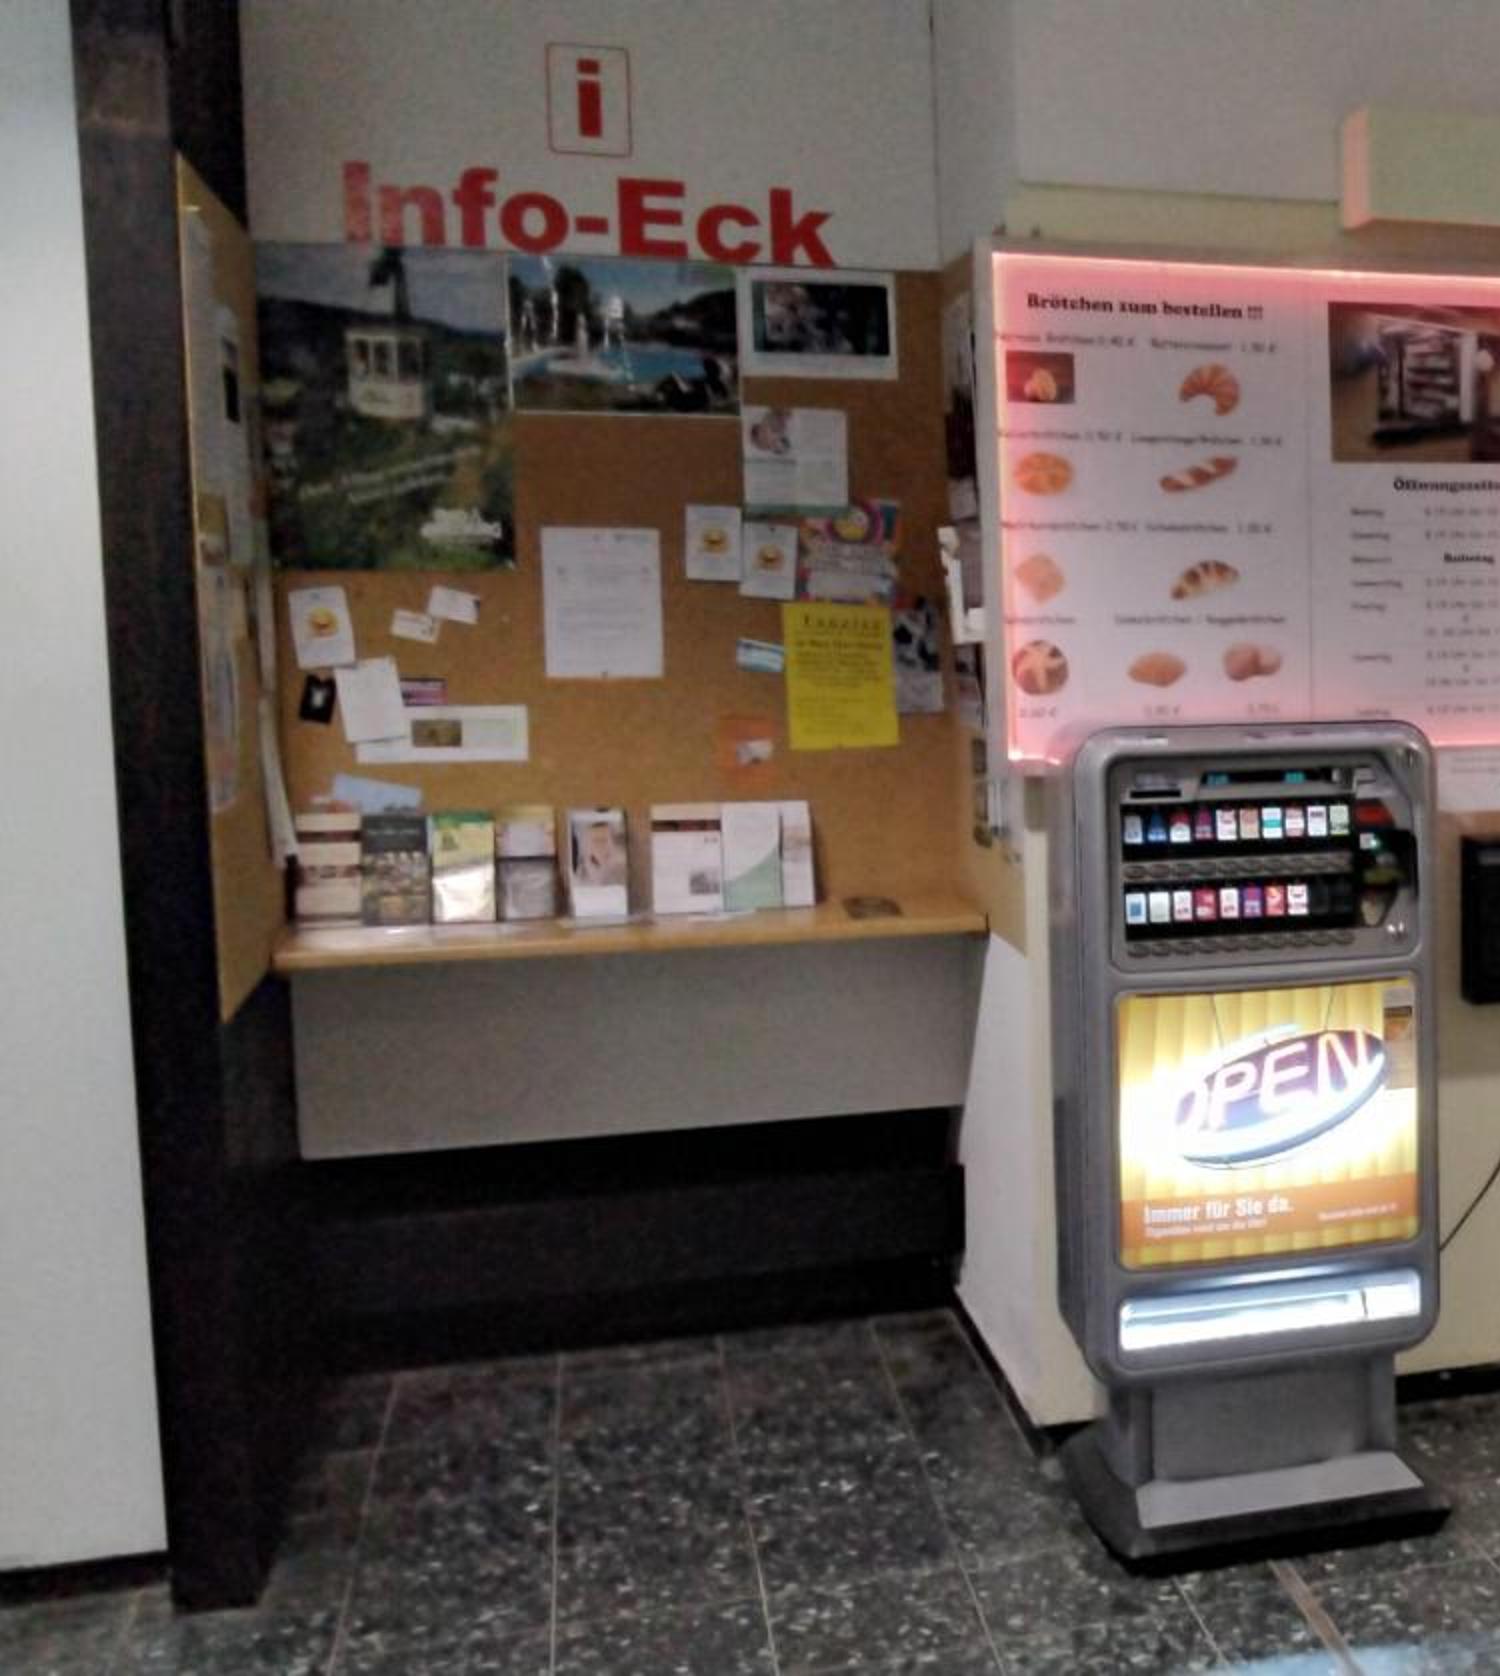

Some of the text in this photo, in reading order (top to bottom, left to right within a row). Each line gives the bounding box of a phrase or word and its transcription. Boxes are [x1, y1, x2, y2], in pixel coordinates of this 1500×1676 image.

[576, 57, 602, 138] i
[341, 160, 836, 269] Info-Eck
[1026, 292, 1114, 313] Brötchen
[1118, 300, 1158, 315] zum
[1162, 300, 1243, 320] bestellen
[1143, 1204, 1201, 1226] Immer
[1205, 1199, 1230, 1221] für
[1235, 1197, 1264, 1218] Sie
